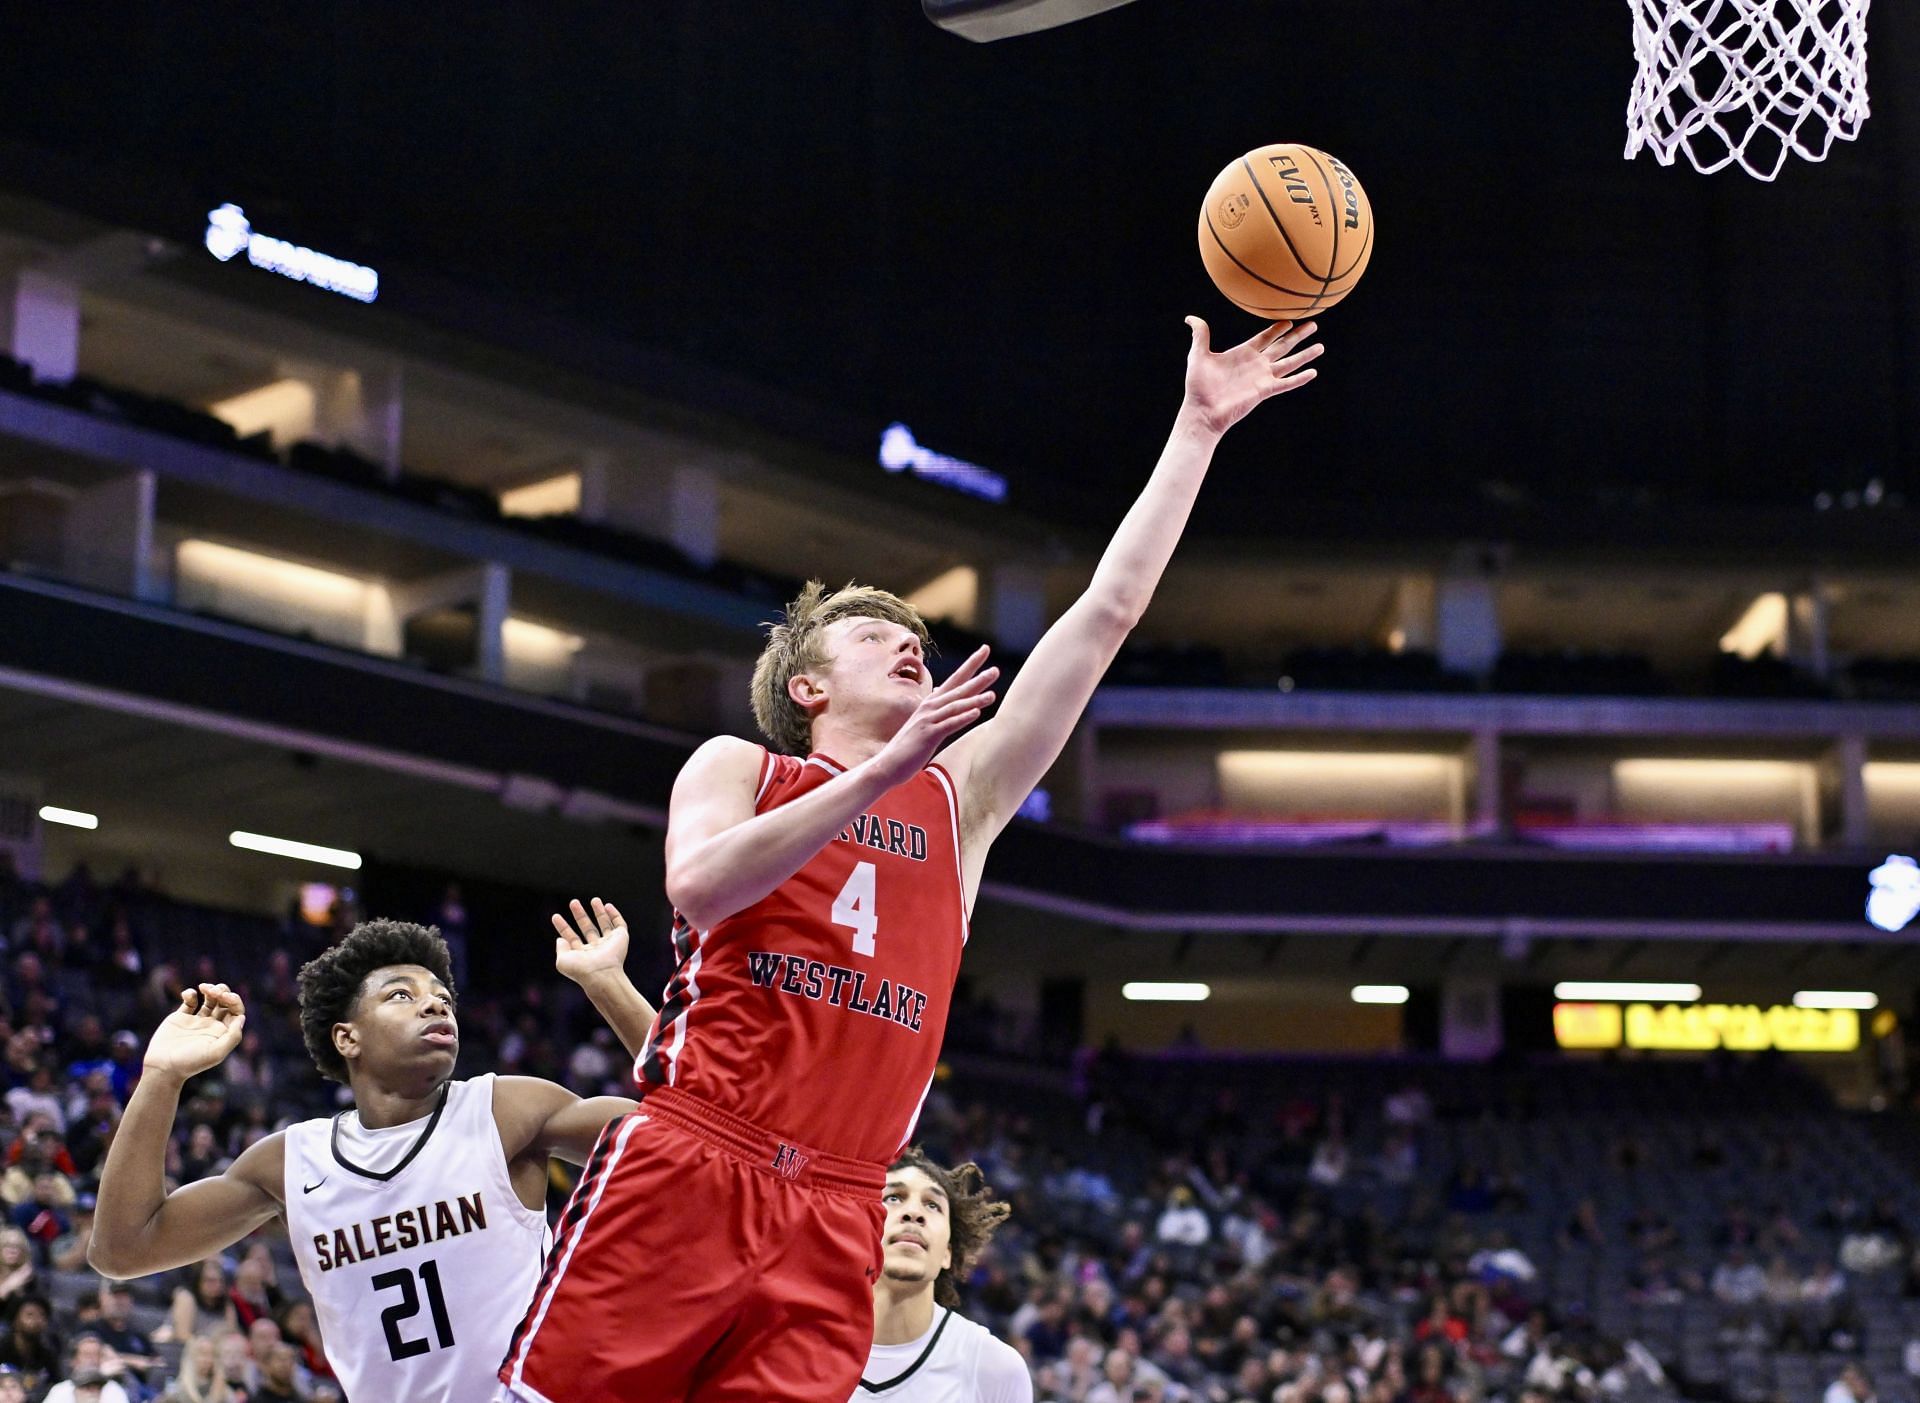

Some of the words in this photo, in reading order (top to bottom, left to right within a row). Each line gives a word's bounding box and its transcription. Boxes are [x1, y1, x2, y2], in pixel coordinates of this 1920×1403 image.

[1269, 155, 1314, 204] EVO
[1308, 205, 1323, 228] NXT
[834, 813, 928, 861] VARD
[831, 860, 878, 957] 4
[747, 951, 928, 1034] WESTLAKE
[313, 1192, 487, 1272] SALESIAN
[371, 1259, 455, 1362] 21
